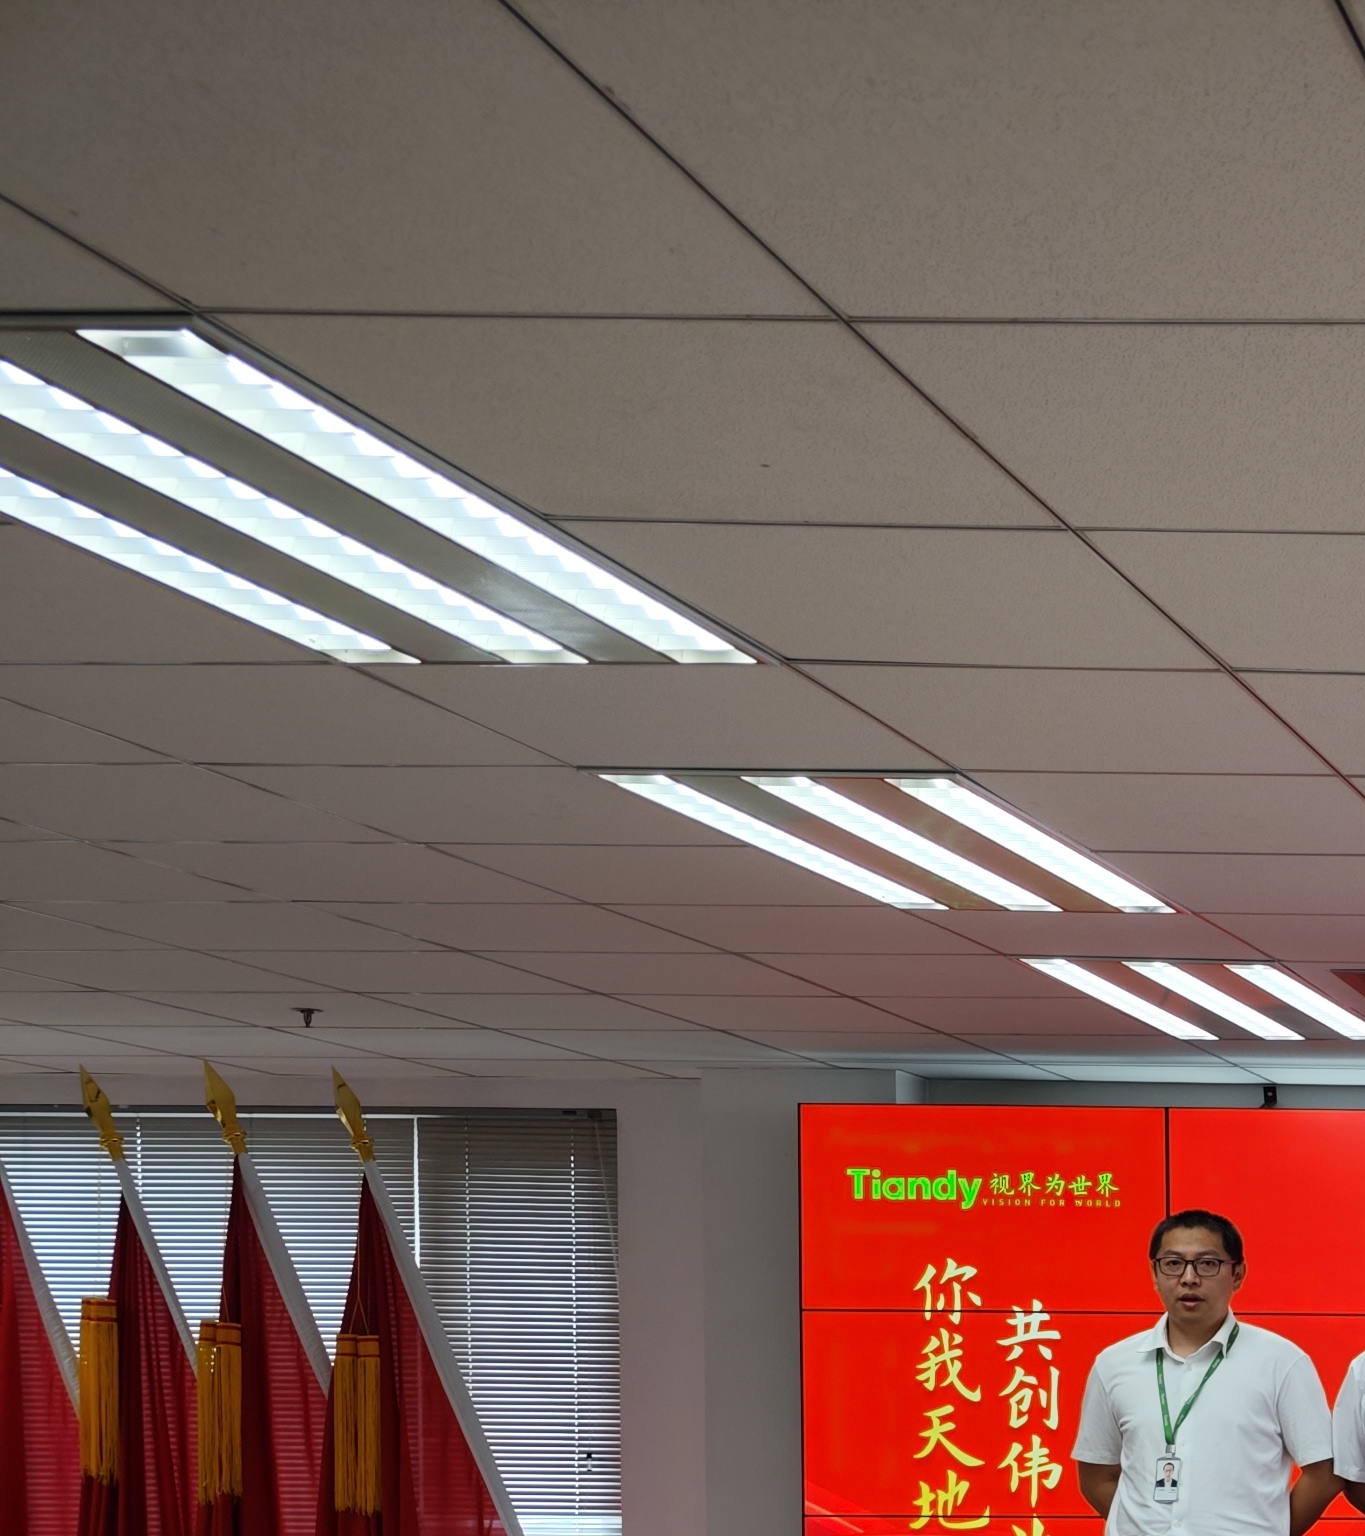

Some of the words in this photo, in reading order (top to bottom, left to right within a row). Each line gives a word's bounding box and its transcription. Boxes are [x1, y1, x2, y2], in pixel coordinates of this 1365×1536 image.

[846, 1168, 982, 1210] Tiandy
[989, 1172, 1120, 1198] 视界为世界
[982, 1198, 1031, 1207] VISION
[1040, 1199, 1065, 1207] FOR
[1074, 1199, 1121, 1207] WORLD
[909, 1257, 991, 1531] 你我天地
